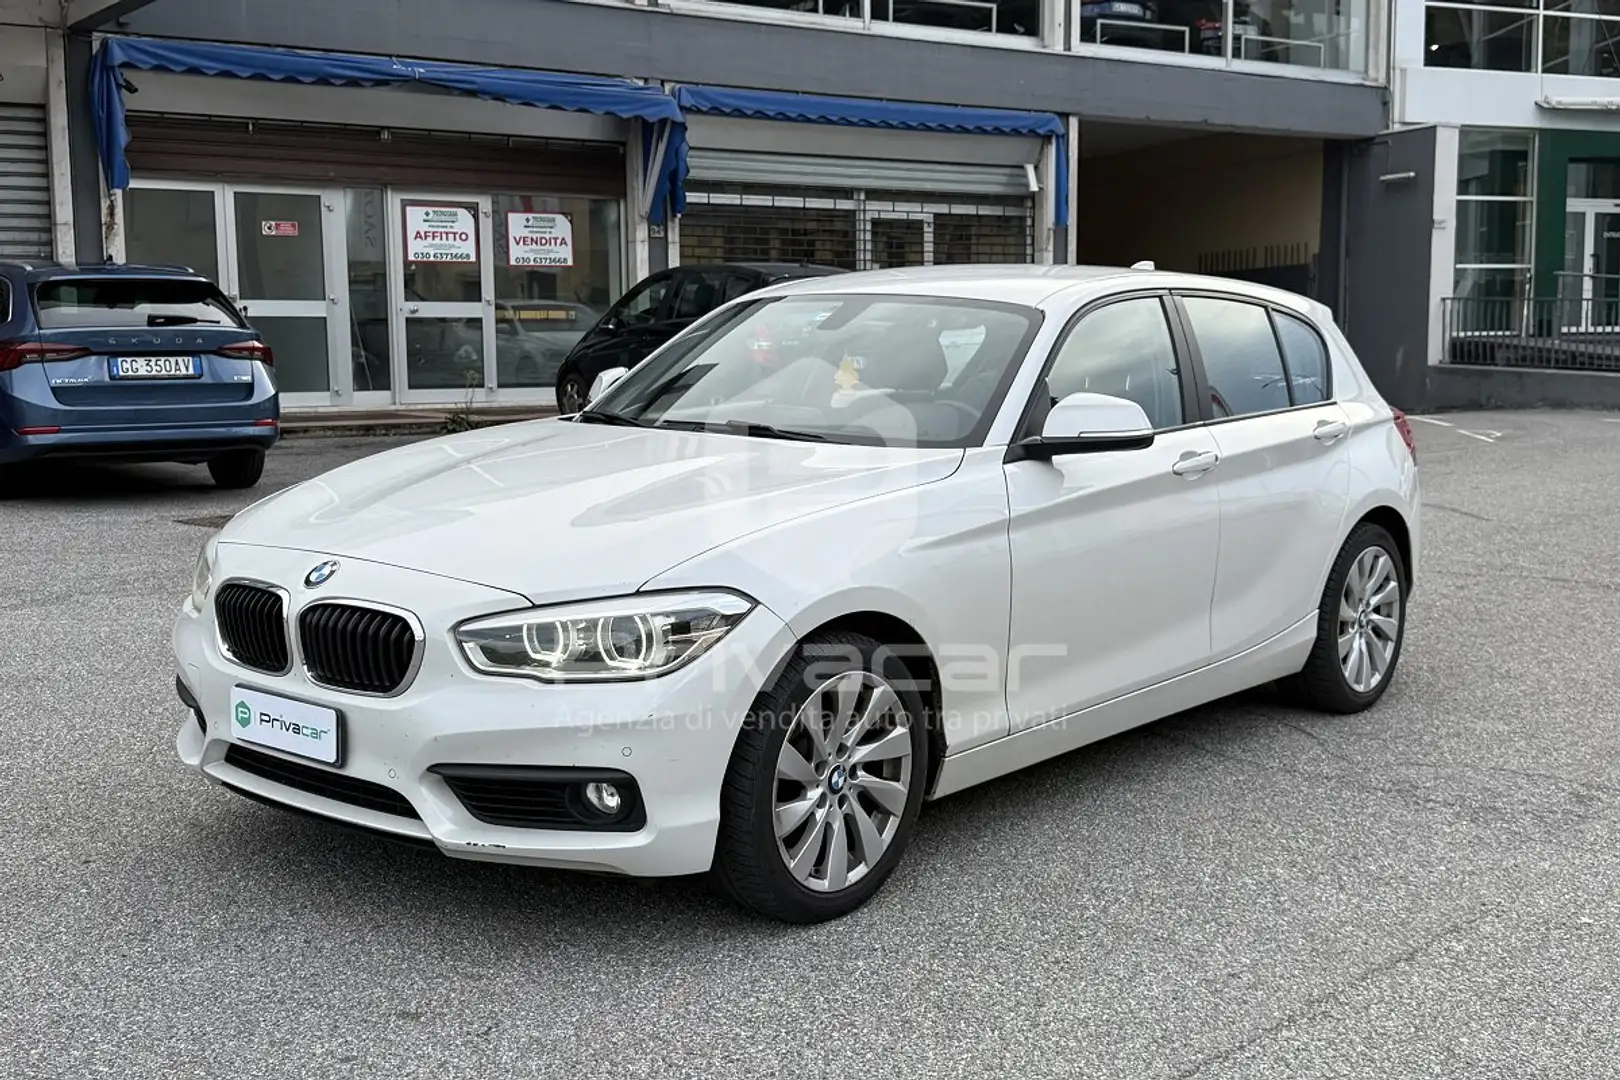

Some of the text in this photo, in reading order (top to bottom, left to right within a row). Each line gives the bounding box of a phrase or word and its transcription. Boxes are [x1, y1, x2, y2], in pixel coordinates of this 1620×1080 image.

[414, 230, 469, 242] AFFITTO
[513, 236, 568, 247] VENDITA
[433, 252, 471, 260] 6373668
[533, 257, 568, 265] 6373668
[259, 711, 329, 740] Privacar
